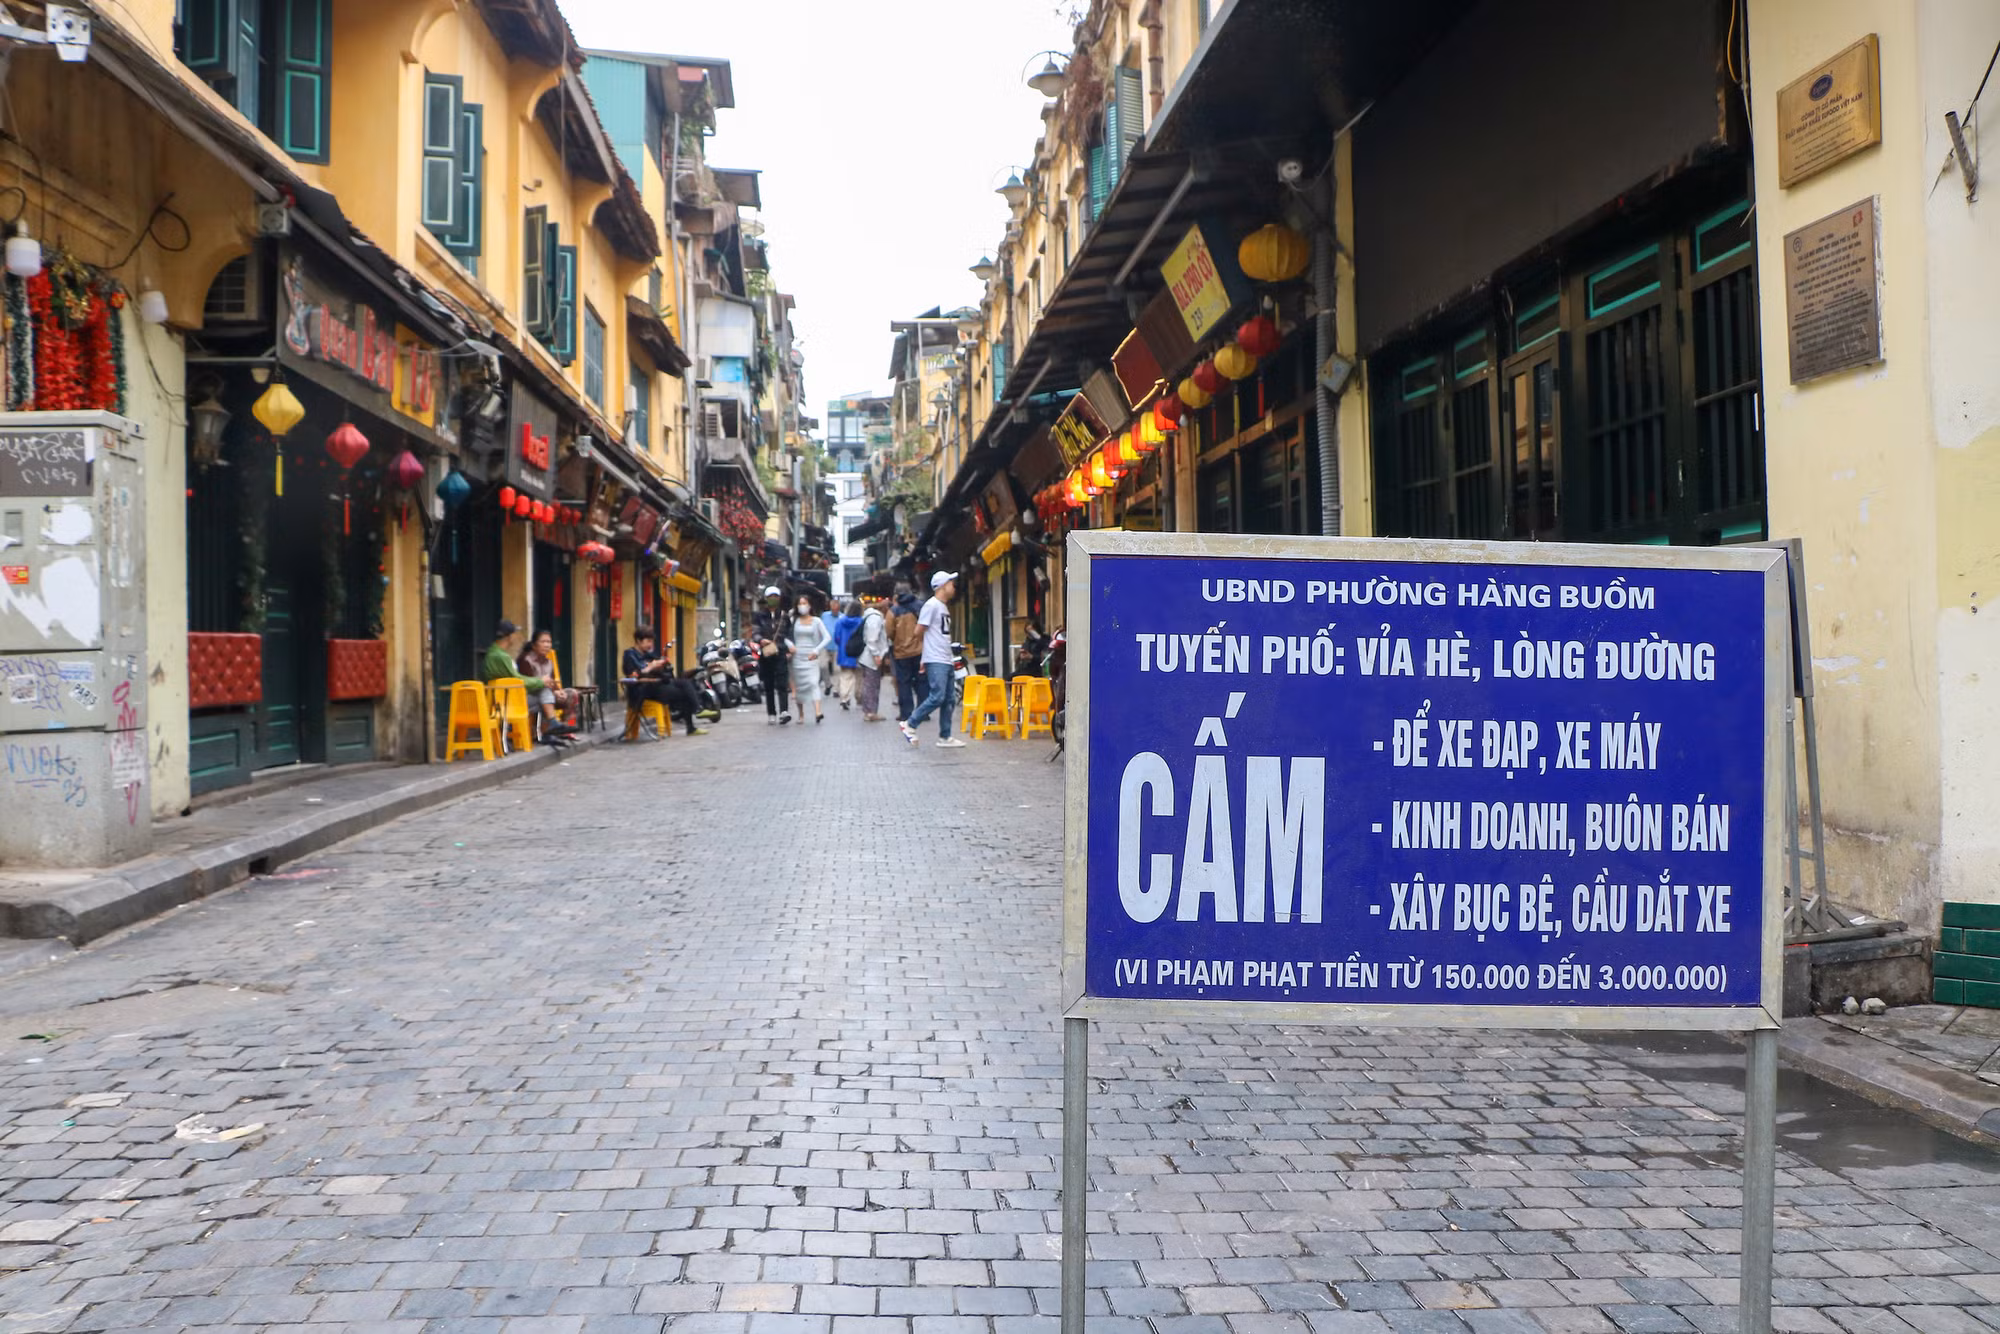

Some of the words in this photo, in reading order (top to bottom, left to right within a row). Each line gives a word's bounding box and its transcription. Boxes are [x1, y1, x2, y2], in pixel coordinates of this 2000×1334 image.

[1203, 579, 1294, 603] UBND
[1307, 576, 1445, 605] PHƯỜNG
[1459, 578, 1550, 607] HÀNG
[1561, 577, 1654, 609] BUỒM
[1136, 621, 1249, 673] TUYẾN
[1263, 623, 1344, 674] PHỐ:
[1357, 623, 1414, 675] VỈA
[1427, 631, 1480, 682] HÈ,
[1494, 631, 1584, 678] LÒNG
[1596, 632, 1714, 680] ĐƯỜNG
[1438, 720, 1472, 767] XE
[1482, 721, 1546, 779] ĐẠP,
[1556, 722, 1590, 768] XE
[1601, 712, 1661, 769] MÁY
[1118, 692, 1325, 923] CẤM
[1471, 802, 1575, 856] DOANH,
[1586, 793, 1662, 851] BUÔN
[1672, 794, 1729, 851] BÁN
[1454, 884, 1509, 942] BỤC
[1519, 874, 1561, 942] BỆ,
[1572, 868, 1627, 932] CẦU
[1637, 869, 1688, 932] DẮT
[1696, 886, 1730, 932] XE
[1115, 959, 1147, 986] (VI
[1157, 960, 1233, 993] PHẠM
[1244, 961, 1313, 994] PHẠT
[1321, 951, 1378, 987] TIỀN
[1387, 956, 1424, 988] TỪ
[1432, 965, 1529, 989] 150.000
[1537, 953, 1590, 989] ĐẾN
[1599, 965, 1726, 992] 3.000.000)
